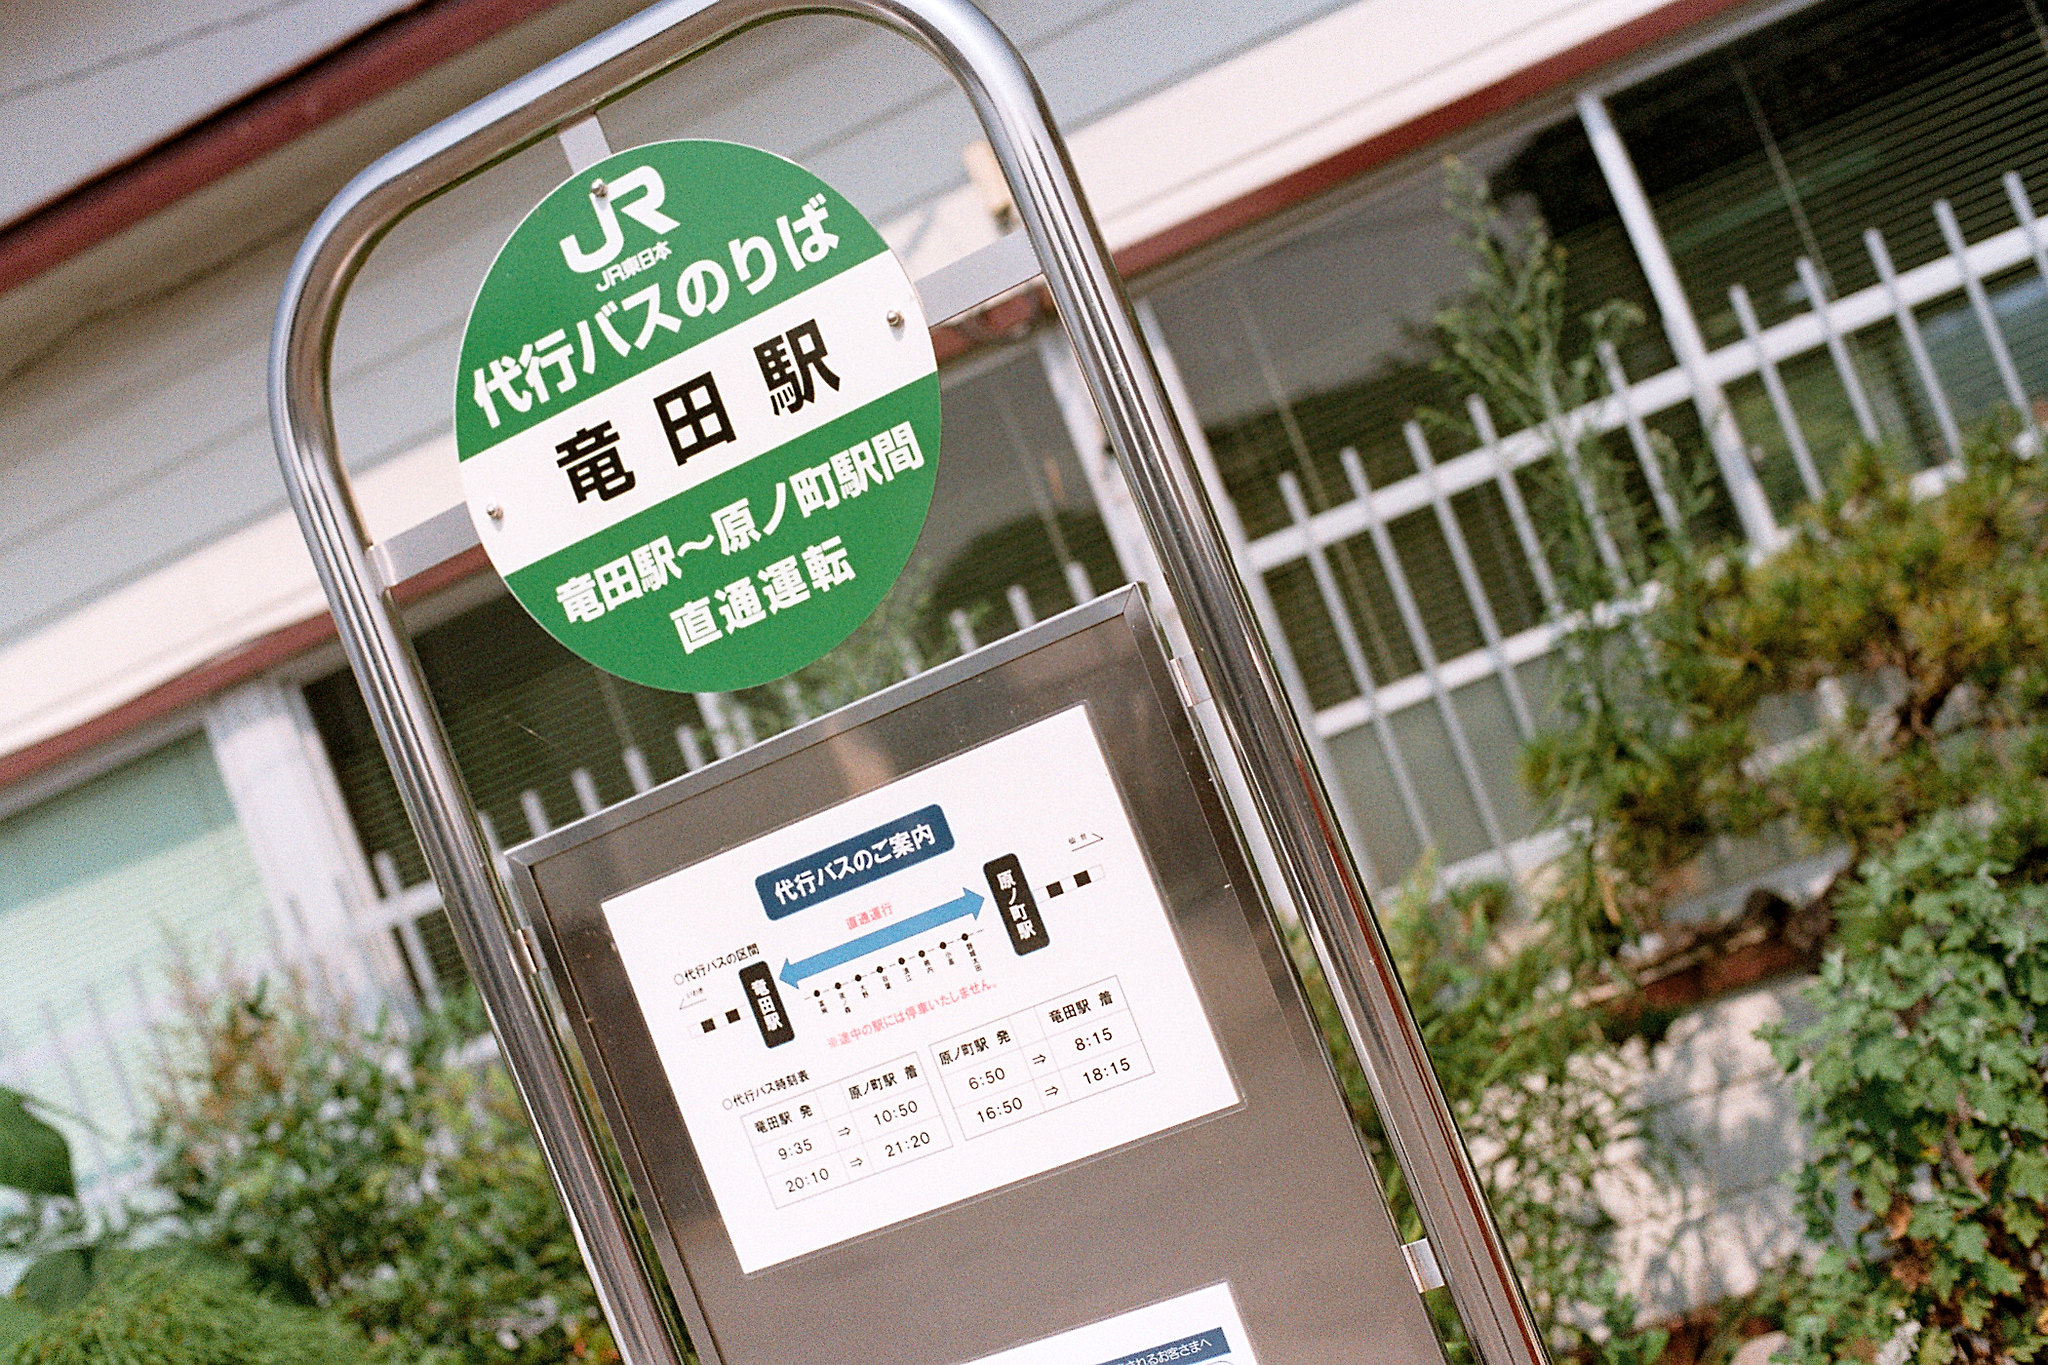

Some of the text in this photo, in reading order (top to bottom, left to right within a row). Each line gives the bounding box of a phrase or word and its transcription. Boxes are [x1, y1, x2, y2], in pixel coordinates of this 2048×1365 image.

[559, 165, 680, 274] JR
[596, 240, 672, 293] JR東日本
[473, 192, 842, 429] 代行バスのりば
[555, 318, 841, 504] 竜田駅
[669, 536, 857, 655] 直通運転
[774, 823, 936, 906] 代行バスのご案内
[997, 870, 1038, 940] 原ノ町駅
[751, 978, 783, 1031] 竜田駅
[1074, 1028, 1113, 1052] 8:15
[968, 1067, 1006, 1091] 6:50
[1083, 1057, 1131, 1085] 18:15
[873, 1100, 918, 1126] 10:50
[976, 1096, 1023, 1124] 16:50
[778, 1138, 813, 1161] 9:35
[884, 1131, 931, 1158] 21:20
[785, 1167, 829, 1193] 20:10
